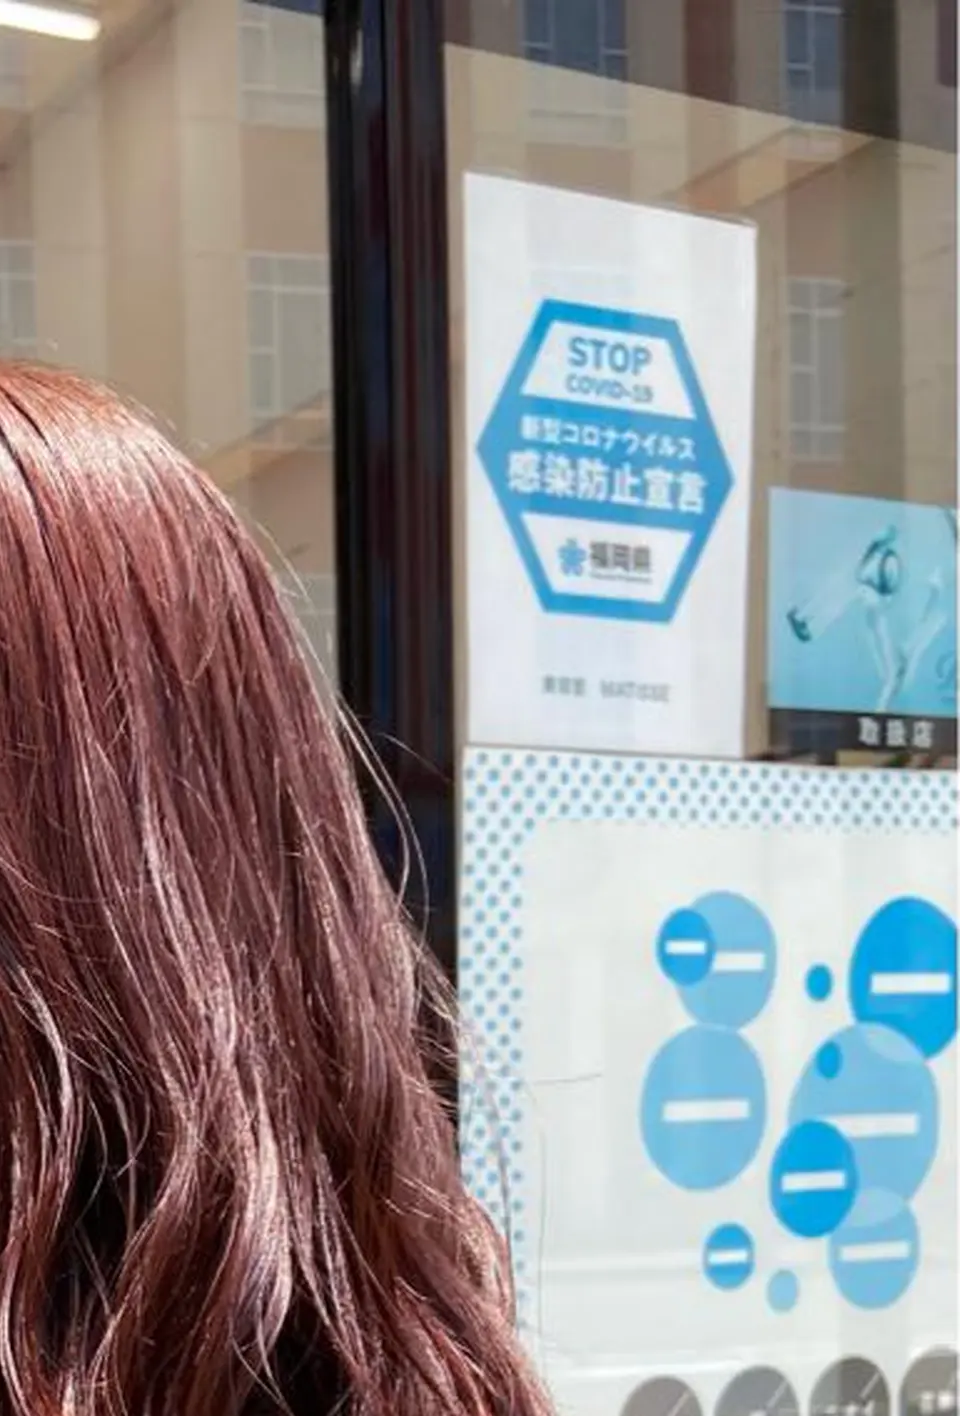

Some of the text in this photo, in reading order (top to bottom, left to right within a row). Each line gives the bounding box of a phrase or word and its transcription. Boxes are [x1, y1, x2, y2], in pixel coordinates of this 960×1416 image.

[567, 336, 653, 376] STOP
[508, 448, 707, 514] 感染防止宣言
